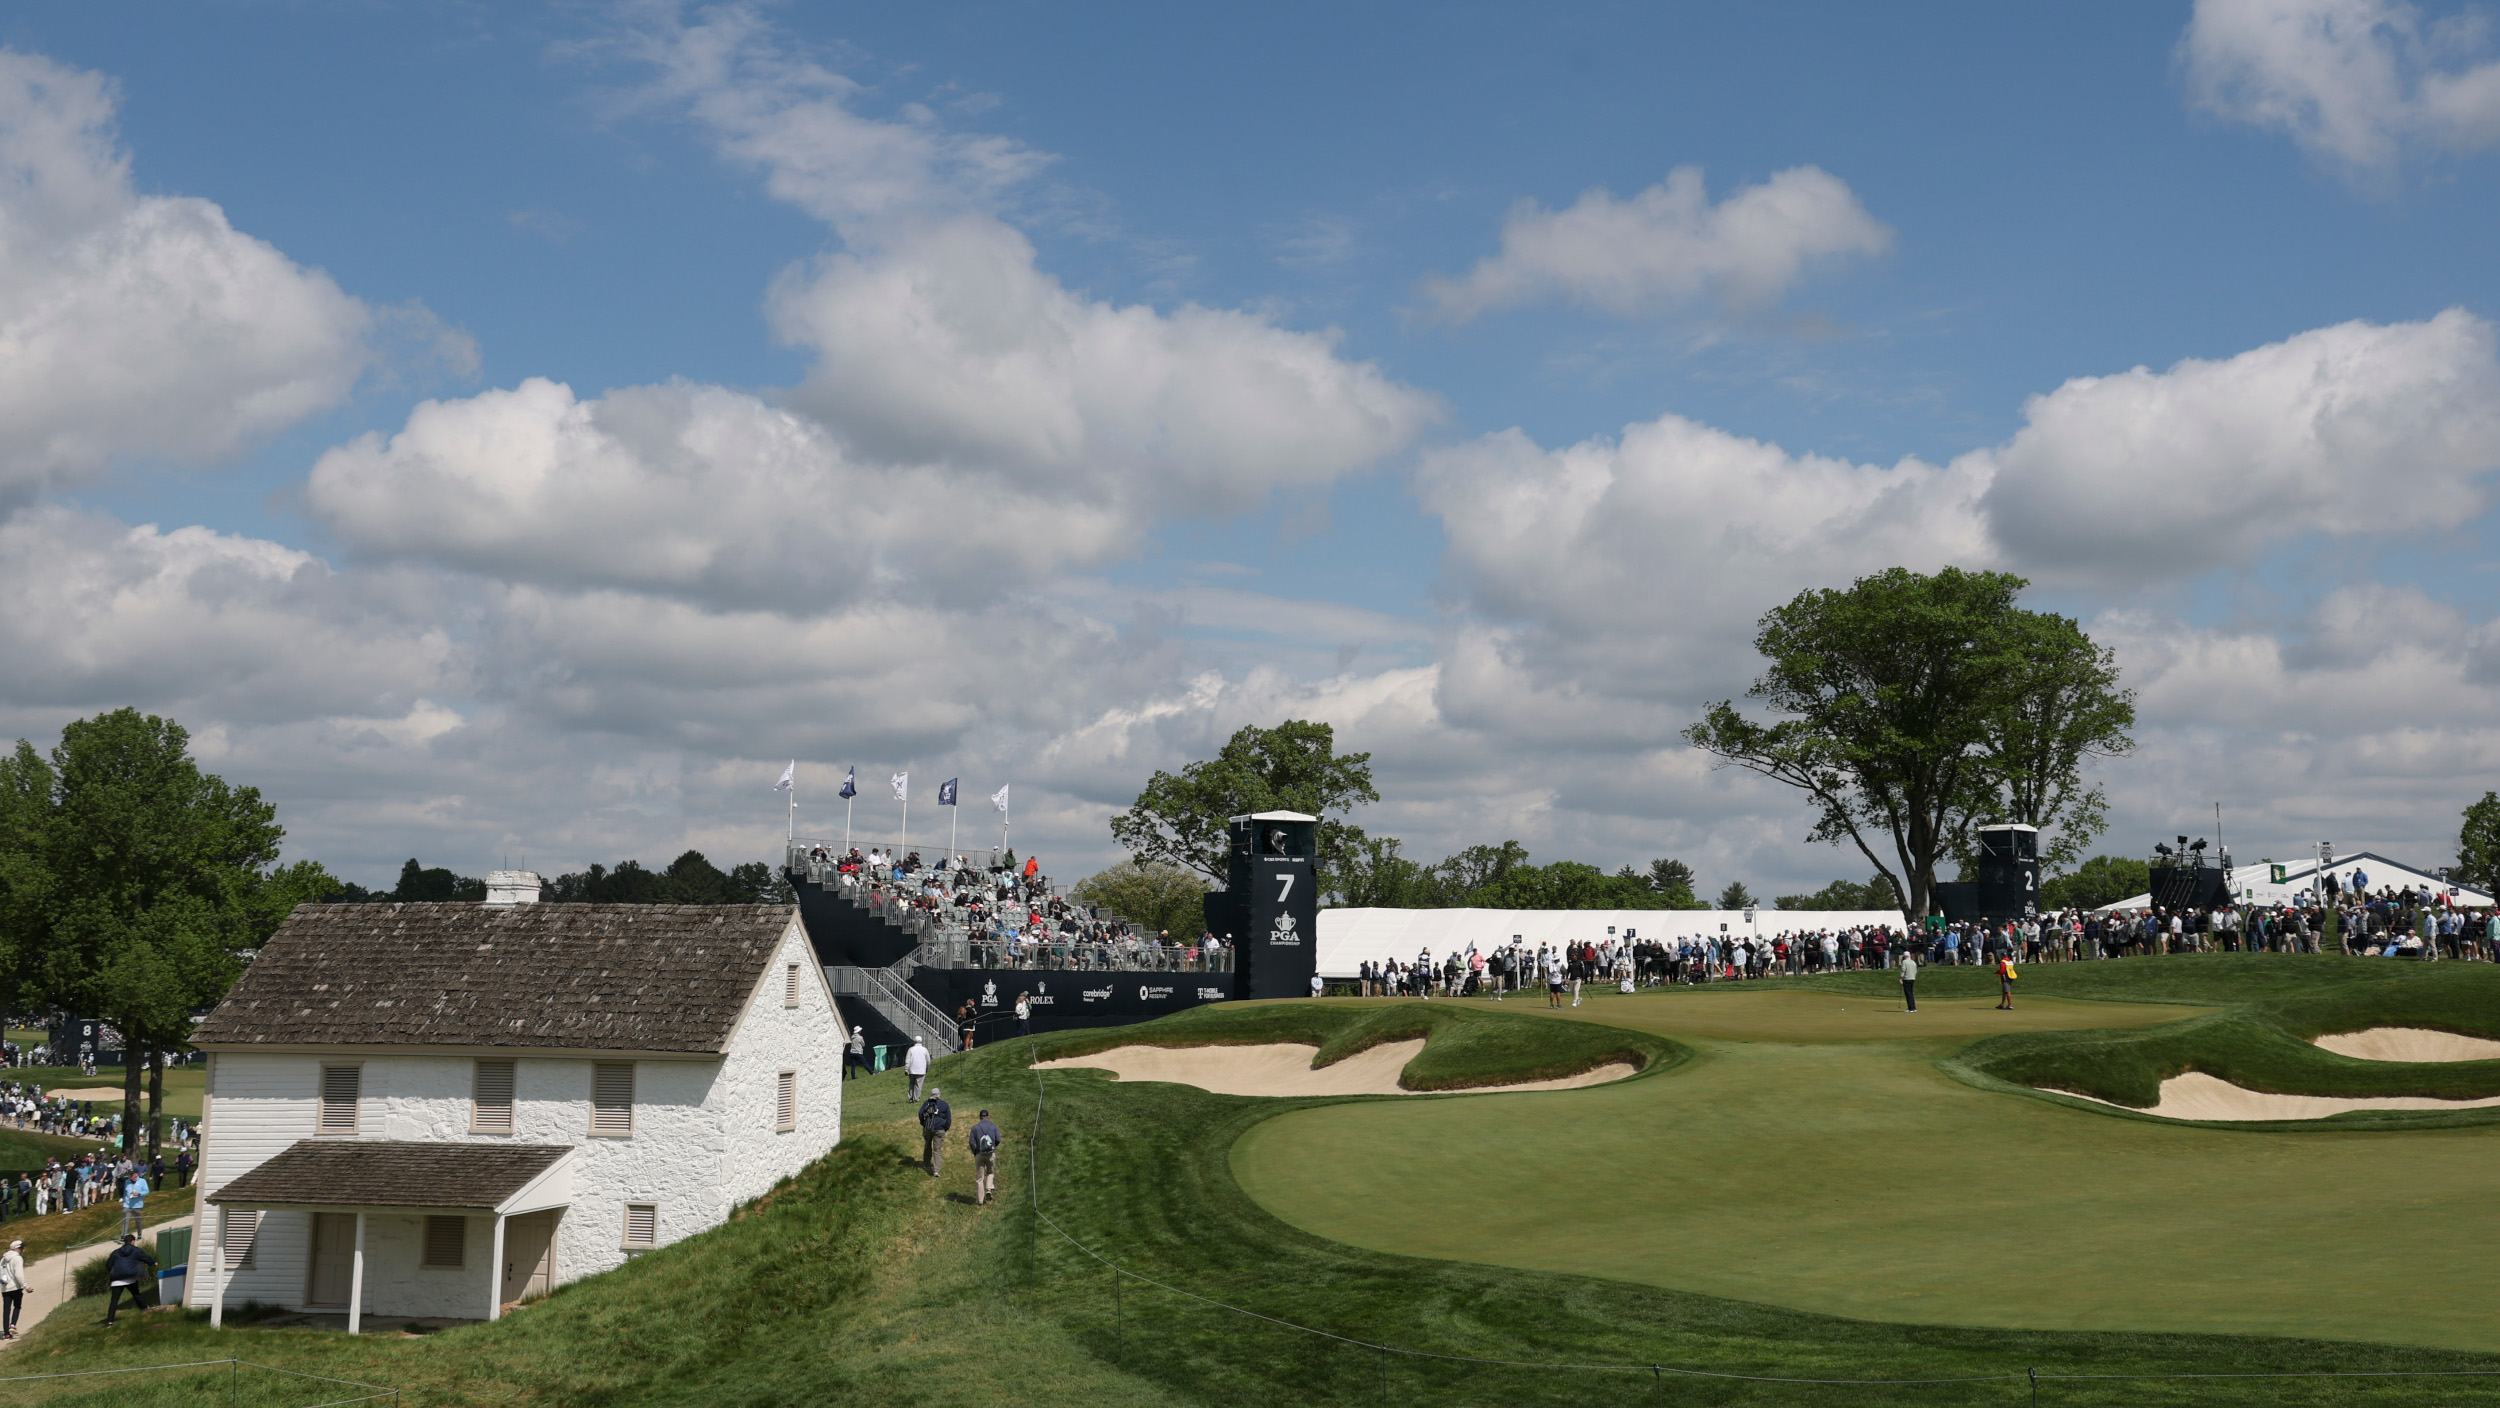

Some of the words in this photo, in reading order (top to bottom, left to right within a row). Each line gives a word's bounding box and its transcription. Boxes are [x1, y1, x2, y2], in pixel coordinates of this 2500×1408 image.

[2025, 870, 2034, 891] 2
[1276, 874, 1294, 902] 7
[2024, 906, 2036, 914] PGA
[1270, 930, 1300, 941] PGA
[981, 995, 998, 1003] PGA
[1083, 990, 1110, 999] corebridge
[1030, 996, 1054, 1005] ROLEX
[83, 1025, 91, 1036] 8
